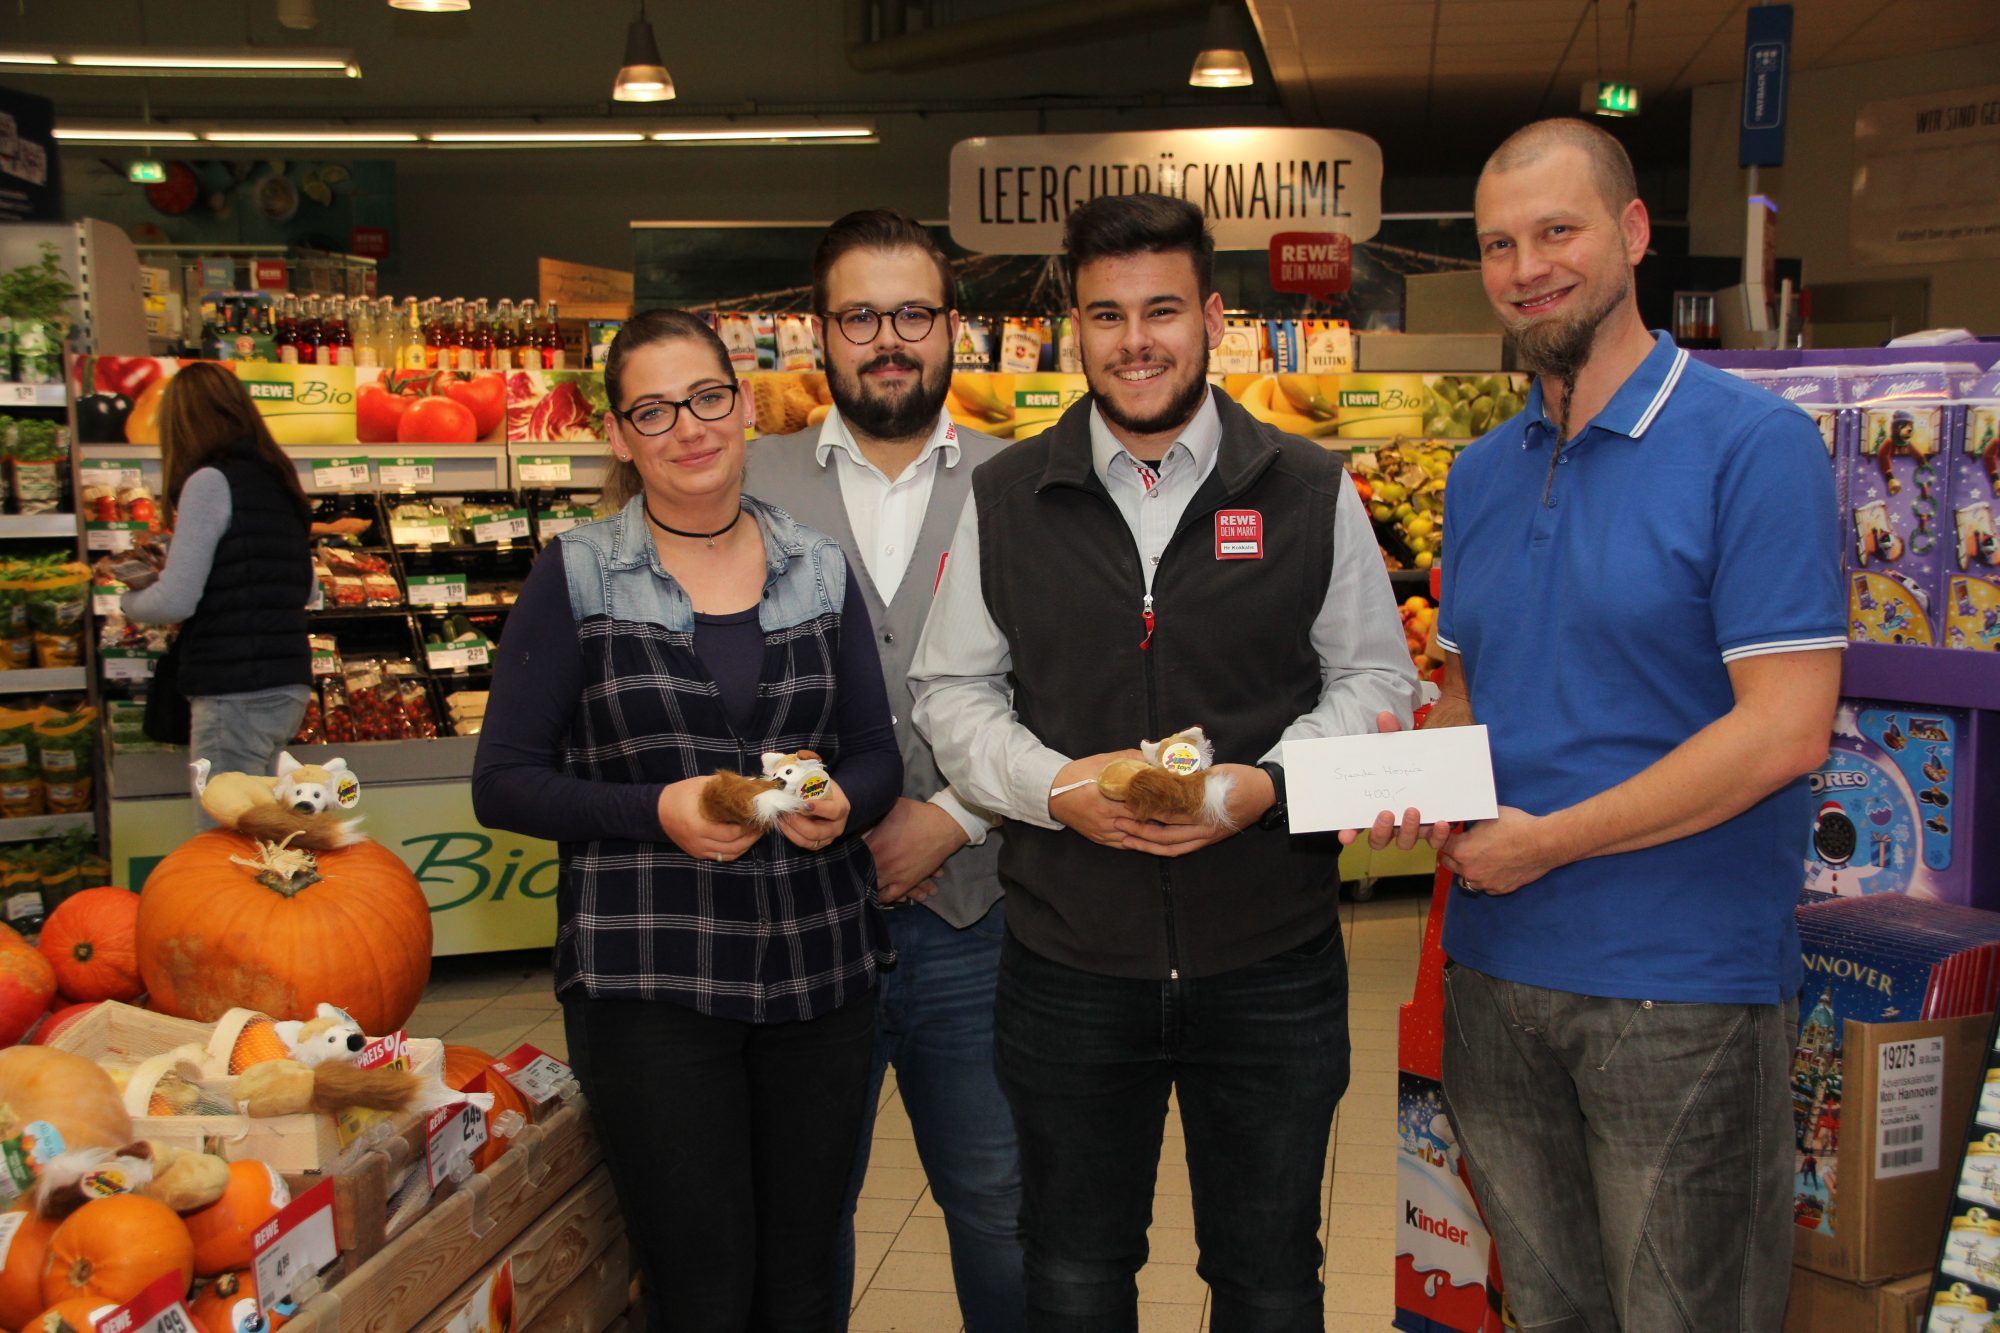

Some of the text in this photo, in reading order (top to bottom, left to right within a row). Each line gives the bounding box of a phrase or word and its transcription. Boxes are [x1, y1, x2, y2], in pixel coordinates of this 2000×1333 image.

[979, 152, 1353, 224] LEERGUTRÜCKNAHME
[1281, 244, 1340, 262] REWE
[1281, 263, 1340, 281] DEIN MARKT
[1313, 356, 1347, 367] VELTINS
[250, 381, 353, 405] REWE Bio
[1780, 383, 1820, 399] Milka
[1883, 380, 1926, 396] Milka
[1025, 394, 1059, 405] REWE
[1348, 389, 1421, 411] REWE Bio
[1220, 515, 1257, 526] REWE
[1220, 526, 1257, 537] DEIN MARKT
[1811, 771, 1868, 792] OREO
[403, 832, 559, 913] Bio
[1882, 1044, 1915, 1070] 19275
[1898, 1085, 1938, 1100] Hannover
[429, 1106, 448, 1132] REWE
[254, 1218, 280, 1249] REWE
